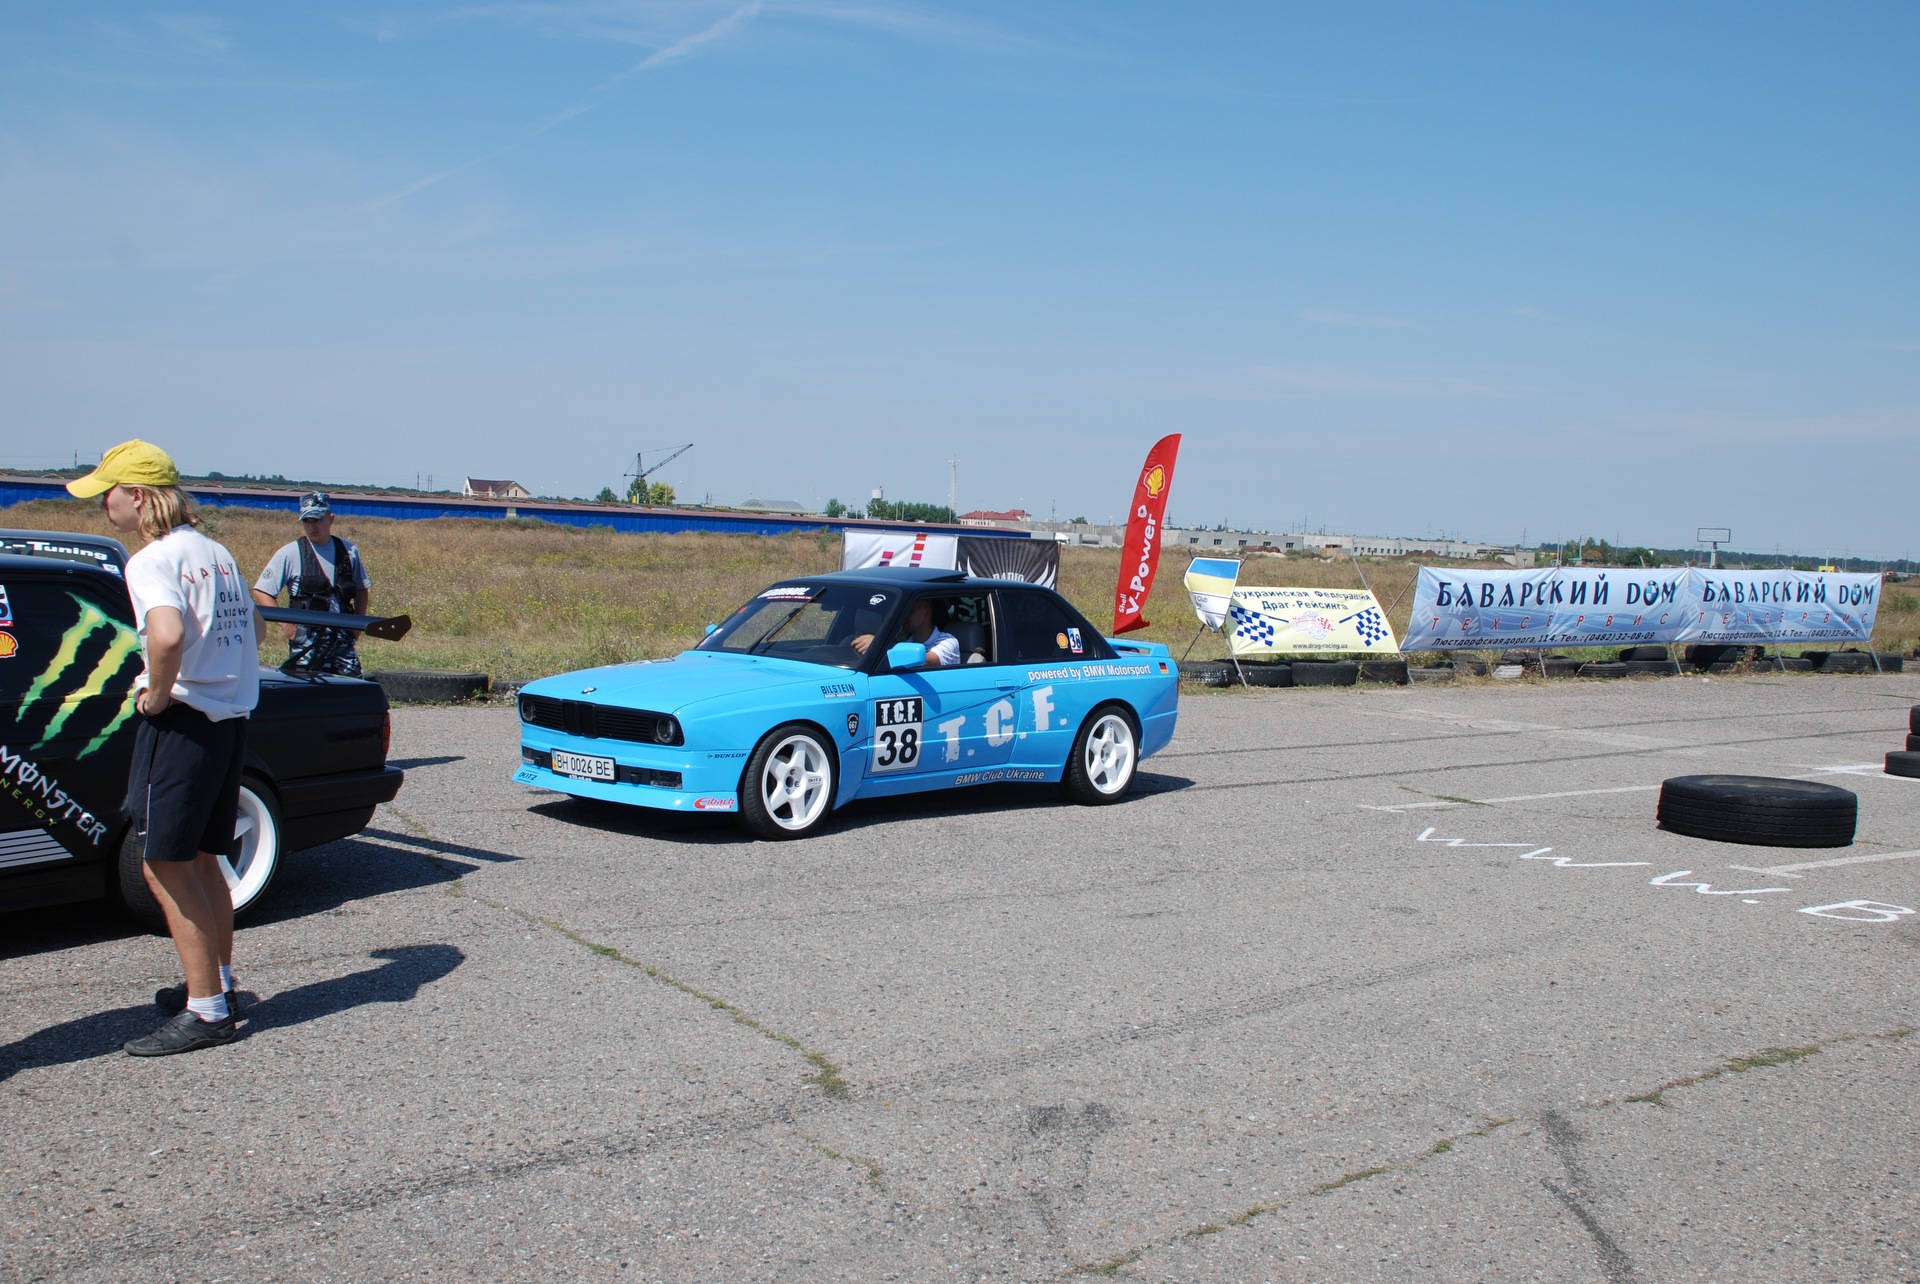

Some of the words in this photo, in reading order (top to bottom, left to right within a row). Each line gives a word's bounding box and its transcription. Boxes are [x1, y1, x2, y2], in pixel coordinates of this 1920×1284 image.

[0, 541, 108, 560] .-Tuning
[1126, 513, 1156, 614] V-Power
[1233, 591, 1309, 599] еукраинская
[1436, 573, 1609, 608] БАВАРСКИЙ
[1702, 576, 1826, 604] БАВАРСКИЙ
[1070, 633, 1081, 648] 38
[1292, 642, 1348, 650] www.drag-racing.ua
[1028, 666, 1068, 683] powered
[1068, 666, 1081, 680] by
[1082, 664, 1106, 677] BMW
[1106, 664, 1151, 677] Motorsport
[820, 684, 855, 694] BILSTEIN
[881, 701, 917, 724] T.C.F.
[878, 728, 918, 766] 38
[557, 754, 568, 770] BH
[571, 757, 593, 774] 0026
[596, 760, 611, 776] BE
[955, 773, 981, 785] BMW
[982, 770, 1004, 780] Club
[1005, 769, 1045, 780] Ukraine
[0, 778, 57, 826] NERGY
[694, 797, 735, 809] Eibach
